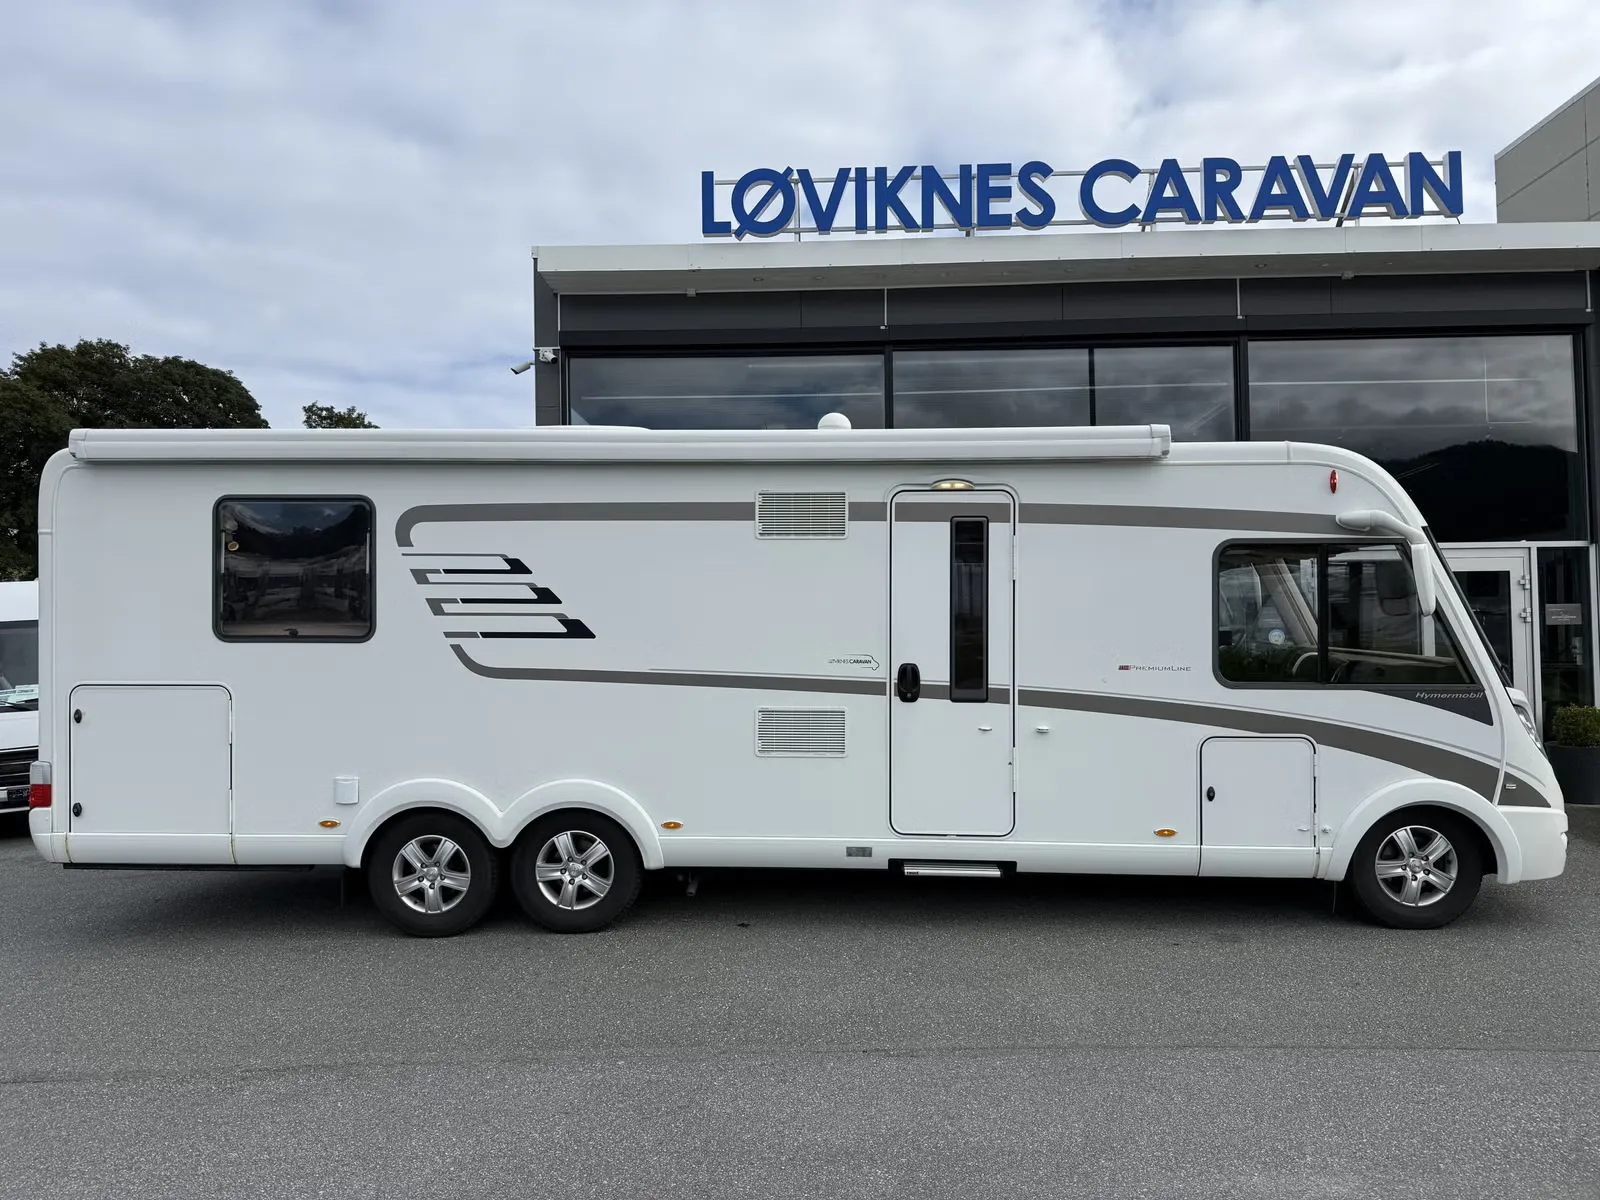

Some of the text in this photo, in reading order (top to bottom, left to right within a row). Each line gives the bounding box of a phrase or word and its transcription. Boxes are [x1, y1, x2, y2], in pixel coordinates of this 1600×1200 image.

[701, 151, 1464, 241] LØVIKNES CARAVAN
[1415, 691, 1484, 699] Hymermobil
